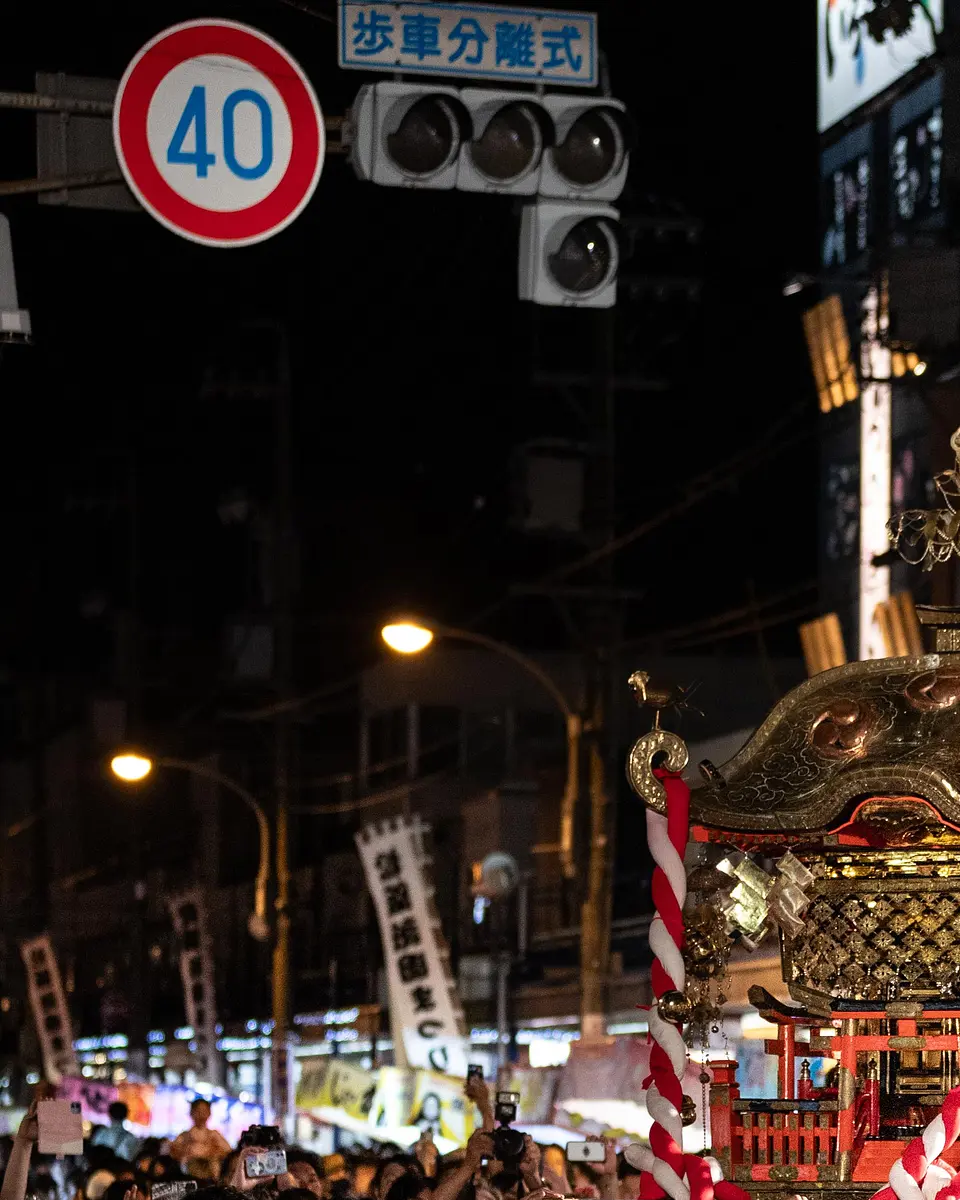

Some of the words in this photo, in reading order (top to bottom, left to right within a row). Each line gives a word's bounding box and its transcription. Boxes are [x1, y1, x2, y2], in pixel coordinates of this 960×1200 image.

[351, 11, 583, 73] 歩車分離式
[167, 85, 274, 181] 40
